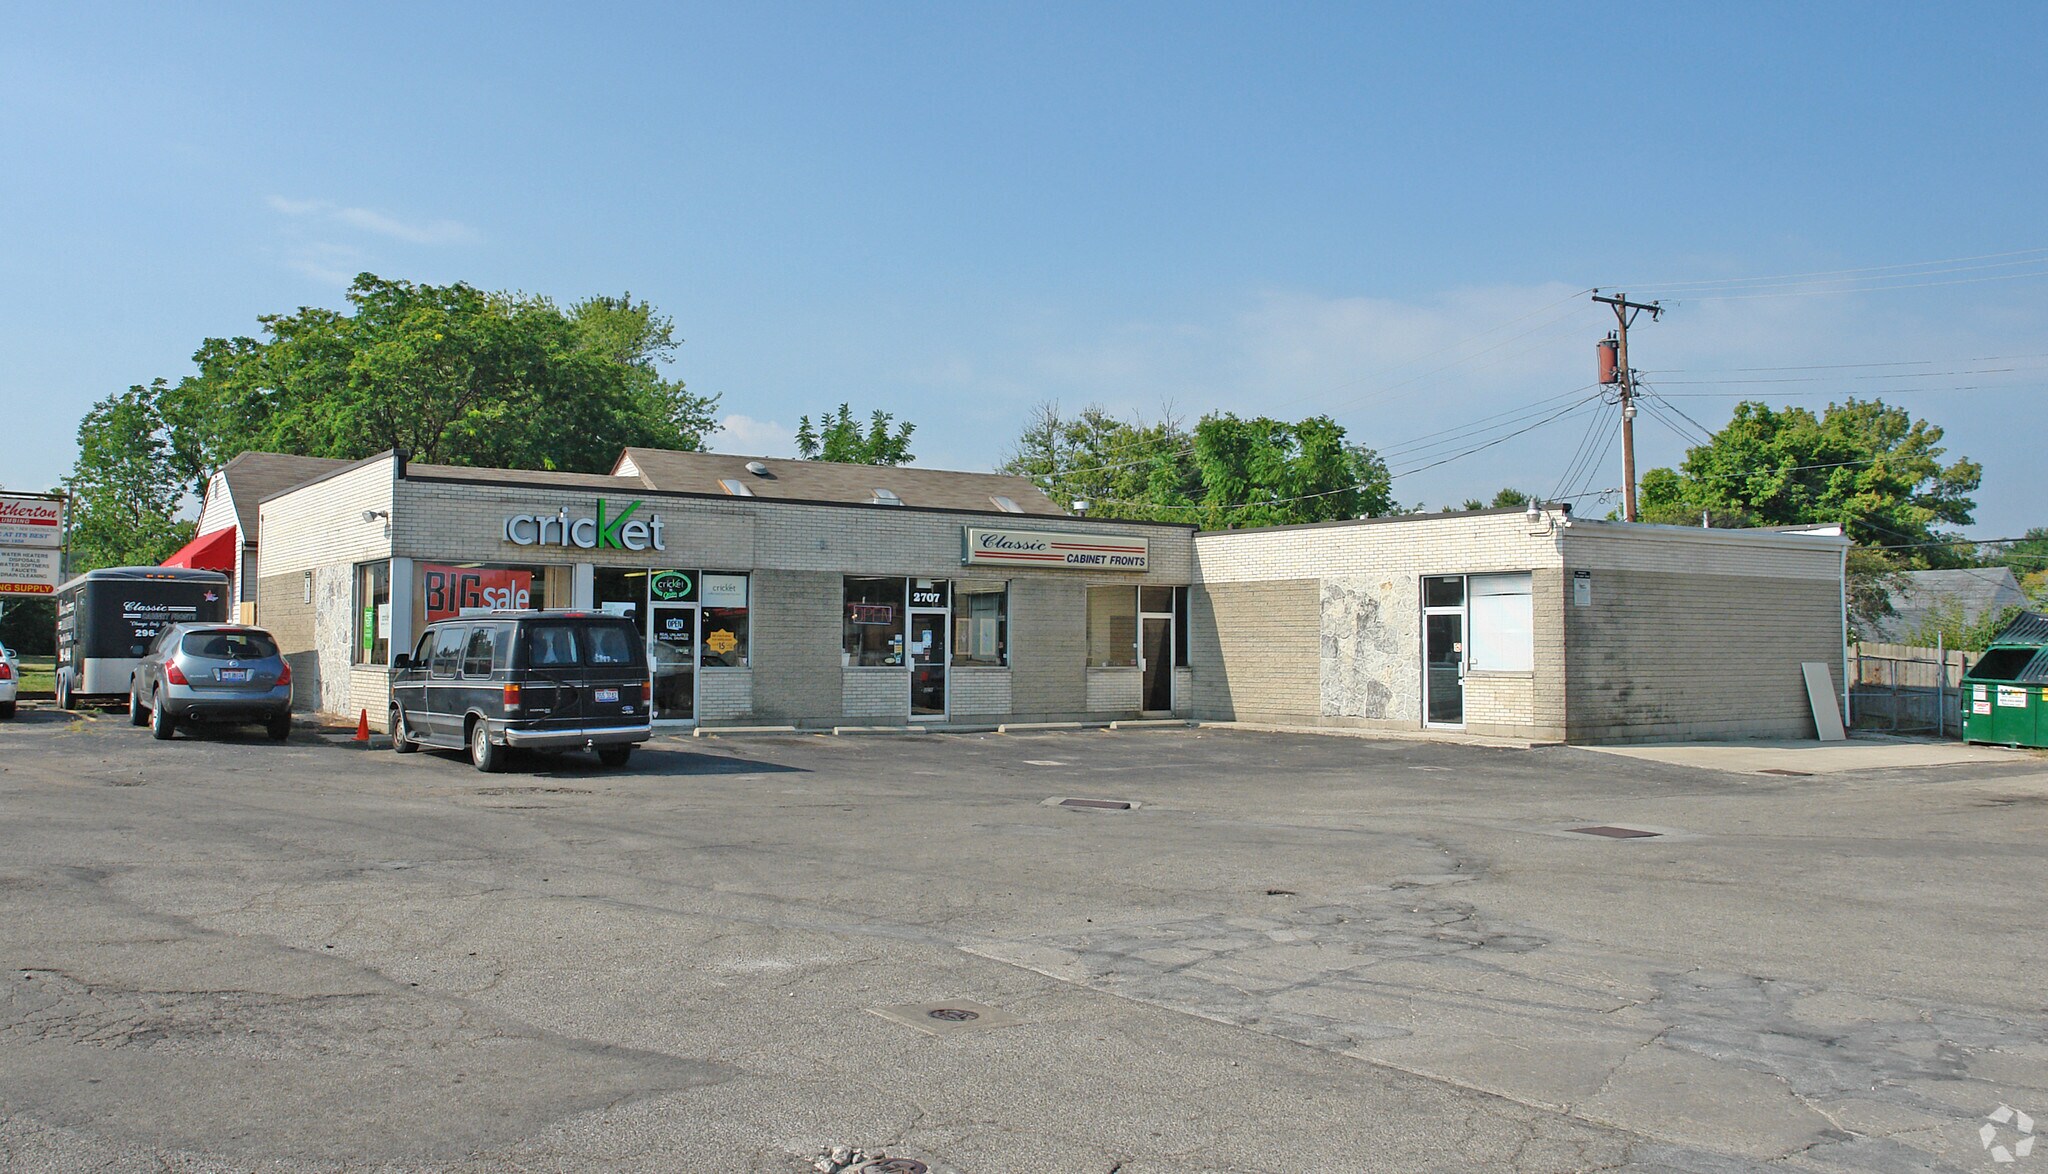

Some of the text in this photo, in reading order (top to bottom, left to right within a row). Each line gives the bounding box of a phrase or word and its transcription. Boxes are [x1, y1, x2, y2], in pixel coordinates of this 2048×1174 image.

[980, 533, 1047, 551] Classic
[1066, 553, 1146, 567] CABINET FRONTS
[14, 584, 51, 593] SUPPLY
[427, 571, 530, 612] BIG sale
[913, 592, 940, 603] 2707
[123, 601, 168, 612] Classic
[668, 621, 682, 629] OPEN
